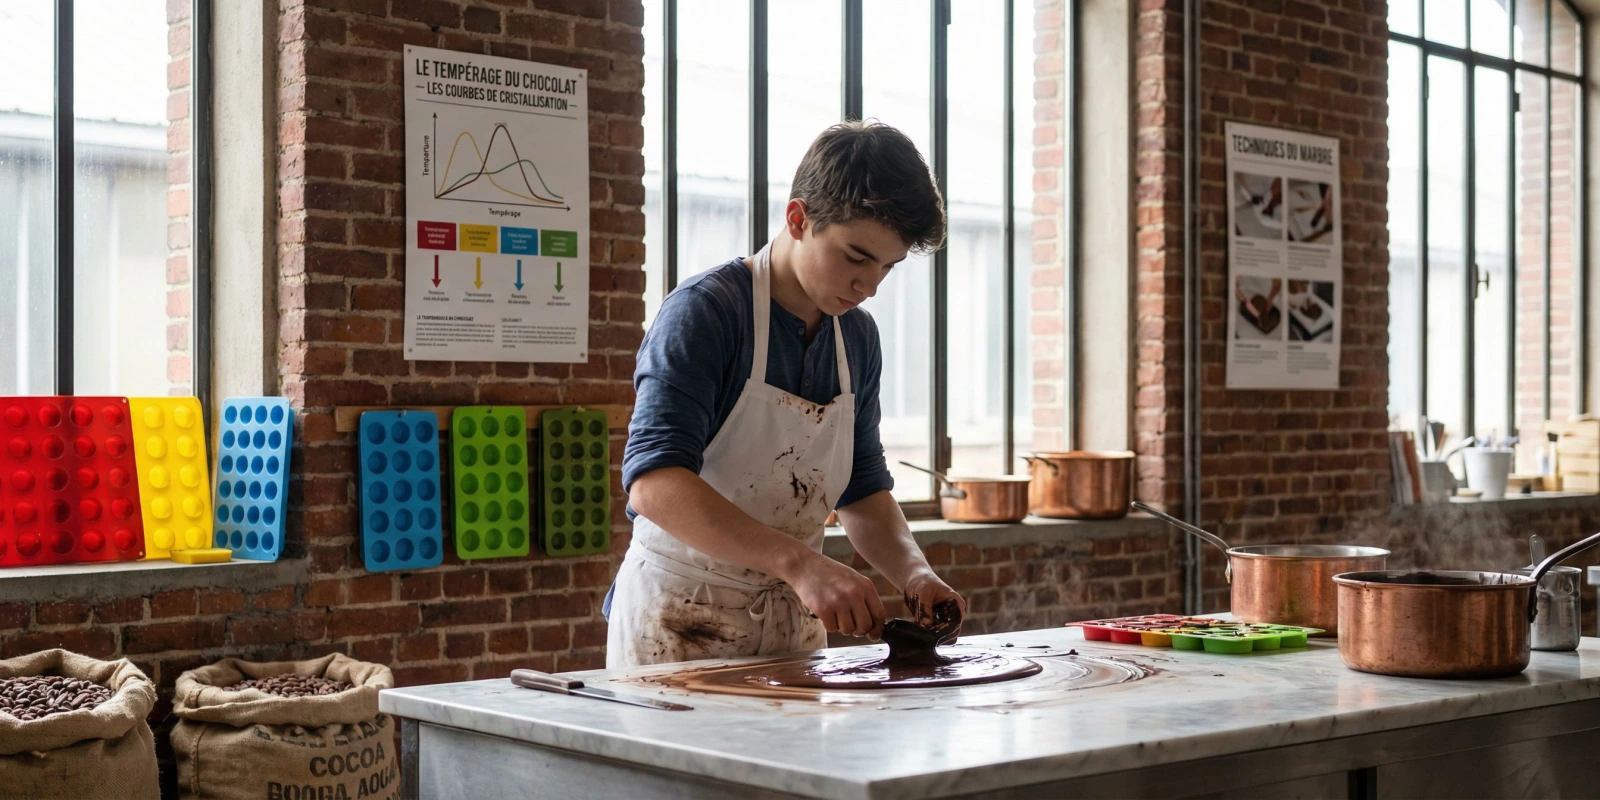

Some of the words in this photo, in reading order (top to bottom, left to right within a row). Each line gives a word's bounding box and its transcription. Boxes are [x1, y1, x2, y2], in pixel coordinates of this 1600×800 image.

[416, 58, 430, 76] LE
[433, 61, 502, 85] TEMPÉRAGE
[505, 71, 520, 88] DU
[523, 73, 577, 95] CHOCOLAT
[427, 81, 443, 95] LES
[445, 84, 485, 101] COURBES
[487, 91, 497, 102] DE
[499, 91, 568, 111] CRISTALLISATION
[1232, 134, 1285, 159] TECHNIQUES
[1287, 142, 1298, 160] DU
[1300, 144, 1333, 165] MARBRE
[488, 207, 521, 219] Tempérage
[310, 741, 385, 777] COCOA
